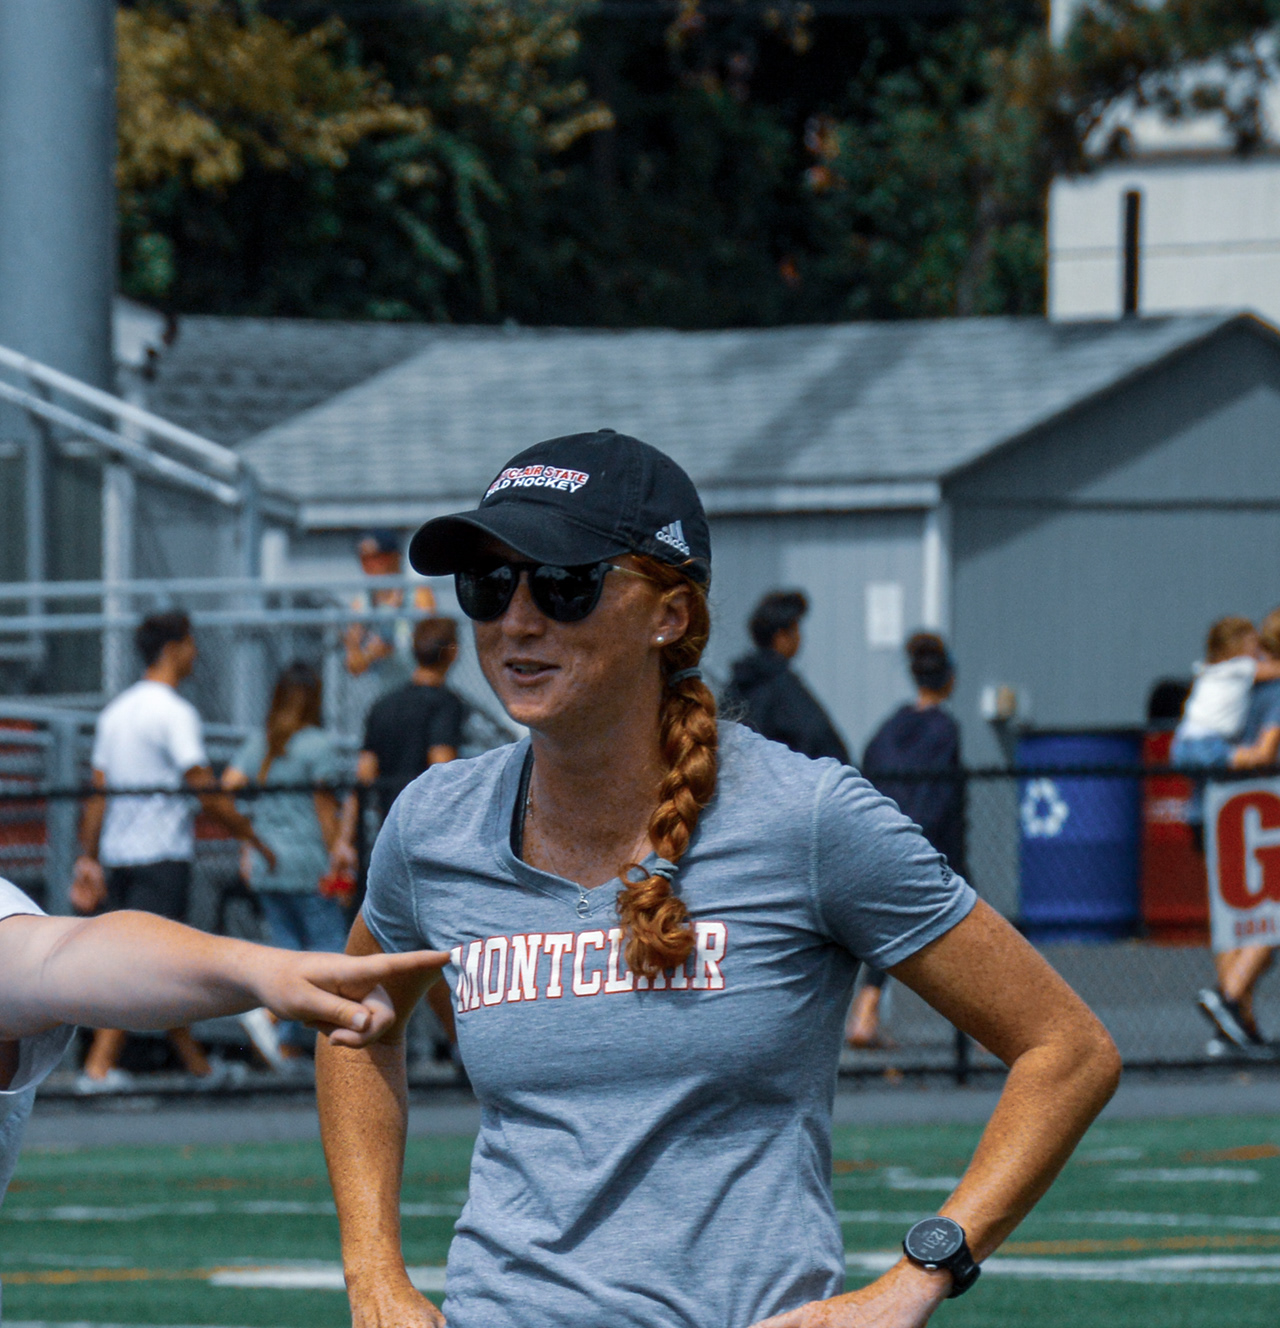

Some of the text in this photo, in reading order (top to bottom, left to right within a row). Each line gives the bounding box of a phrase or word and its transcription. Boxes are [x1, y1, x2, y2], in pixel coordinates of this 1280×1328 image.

[512, 477, 583, 493] HOCKEY
[543, 466, 589, 485] STATE
[451, 920, 728, 1014] MONTCLR
